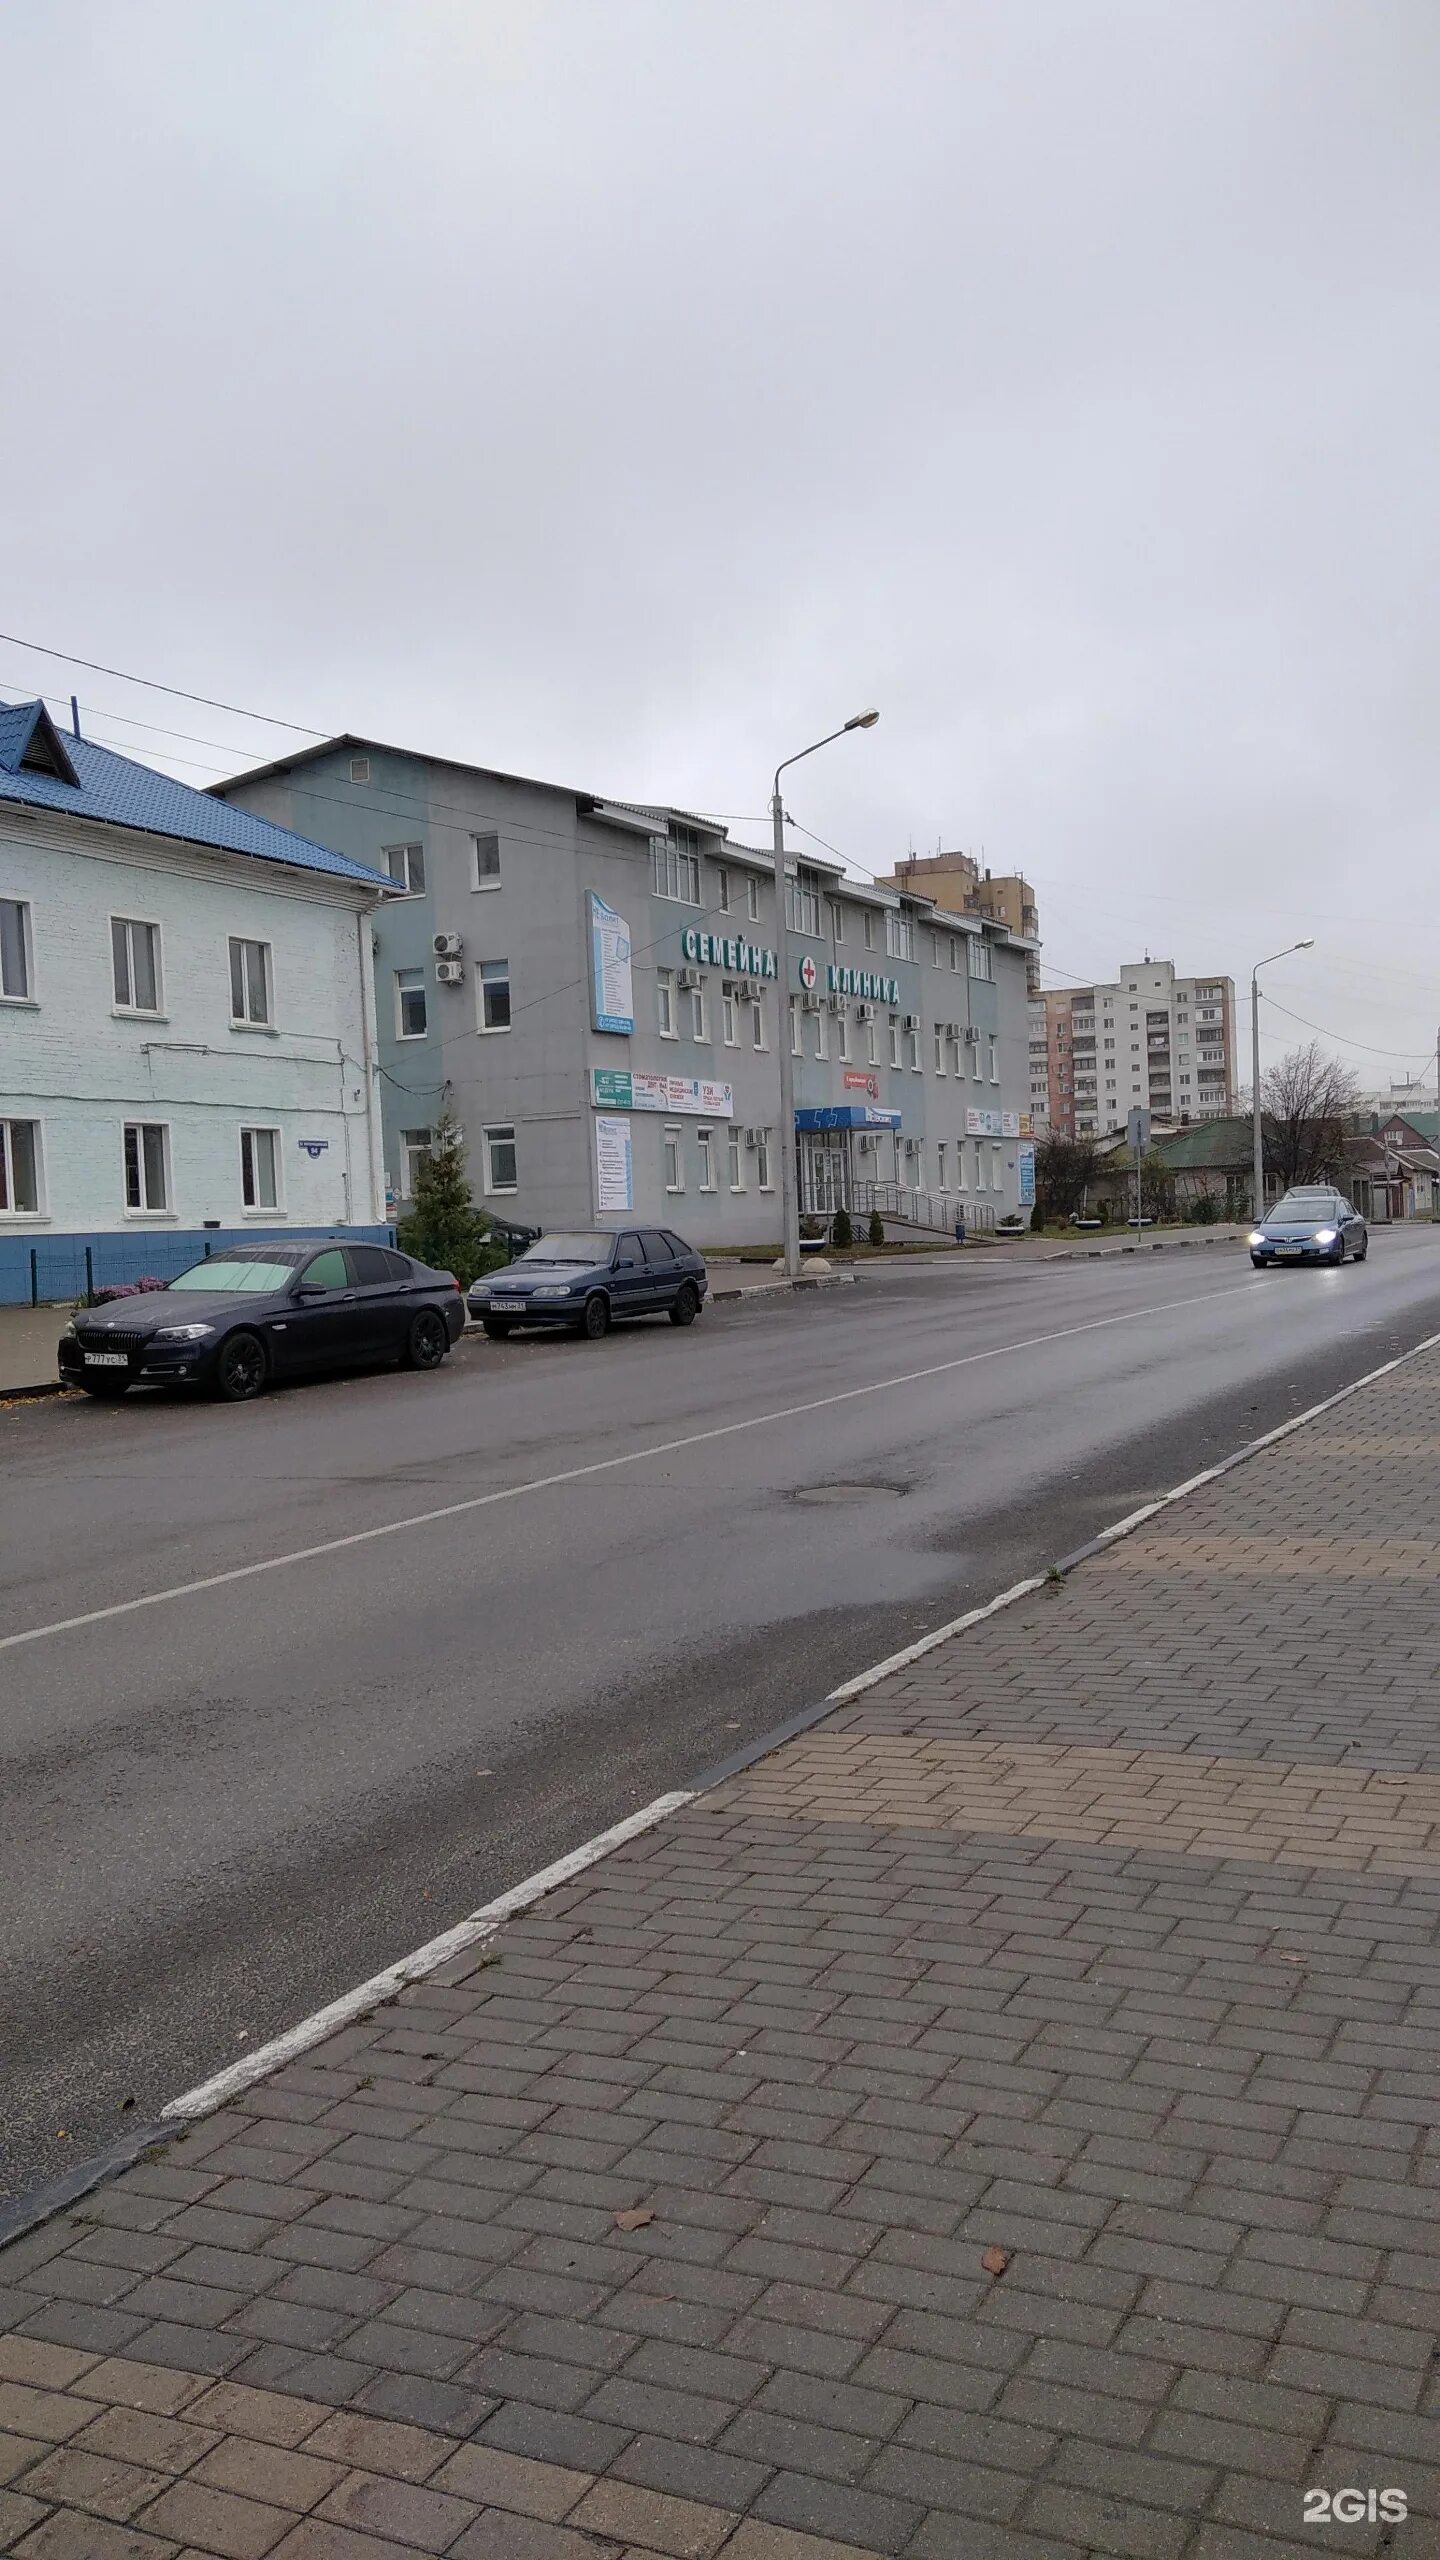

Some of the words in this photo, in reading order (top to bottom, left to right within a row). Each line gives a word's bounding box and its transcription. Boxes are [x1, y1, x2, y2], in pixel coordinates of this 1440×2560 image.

[683, 929, 778, 979] СЕМЕЙНА
[830, 965, 900, 1005] КЛИНИКА
[702, 1085, 714, 1096] УЗИ
